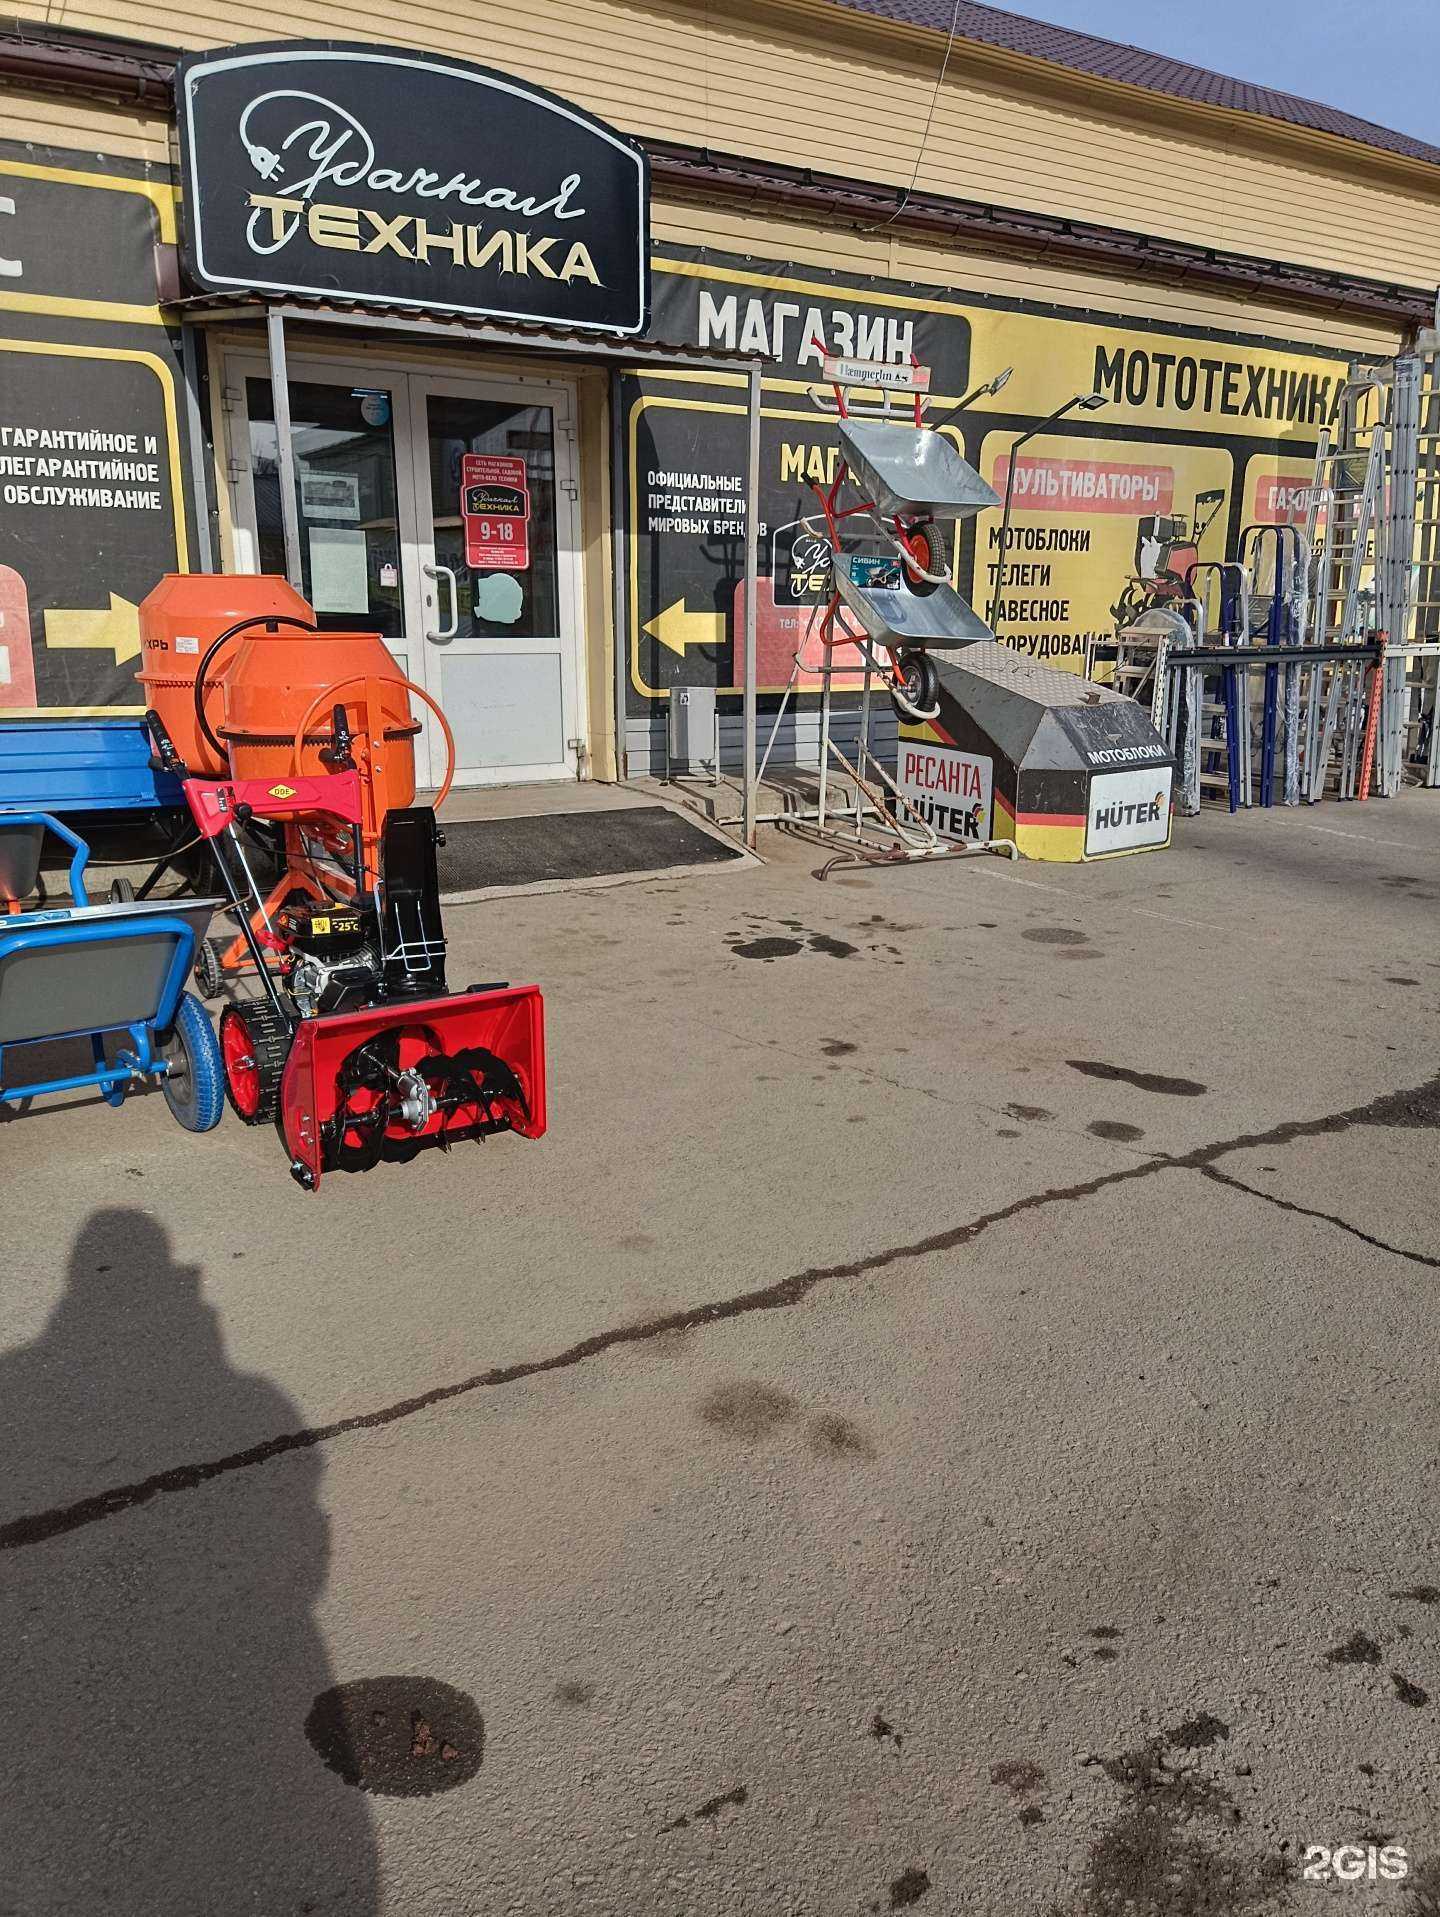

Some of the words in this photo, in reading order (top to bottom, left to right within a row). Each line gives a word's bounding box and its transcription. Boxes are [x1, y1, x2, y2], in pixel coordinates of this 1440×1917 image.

[249, 193, 602, 286] ТЕХНИКА
[698, 291, 914, 368] МАГАЗИН
[1, 427, 139, 454] ГАРАНТИЙНОЕ
[144, 435, 158, 454] И
[647, 470, 743, 492] ОФИЦИАЛЬНЫЕ
[4, 484, 162, 510] ОБСЛУЖИВАНИЕ
[480, 521, 514, 541] 9-18
[648, 516, 710, 535] МИРОВЫХ
[713, 520, 768, 538] БРЕНВ
[988, 526, 1091, 552] МОТОБЛОКИ
[987, 563, 1051, 587] ТЕЛЕГИ
[984, 599, 1070, 622] НАВЕСНОЕ
[1087, 744, 1167, 765] МОТОБЛОКИ
[904, 752, 982, 800] РЕСАНТА
[903, 794, 980, 840] HÜTER
[1095, 800, 1161, 831] HÜTER
